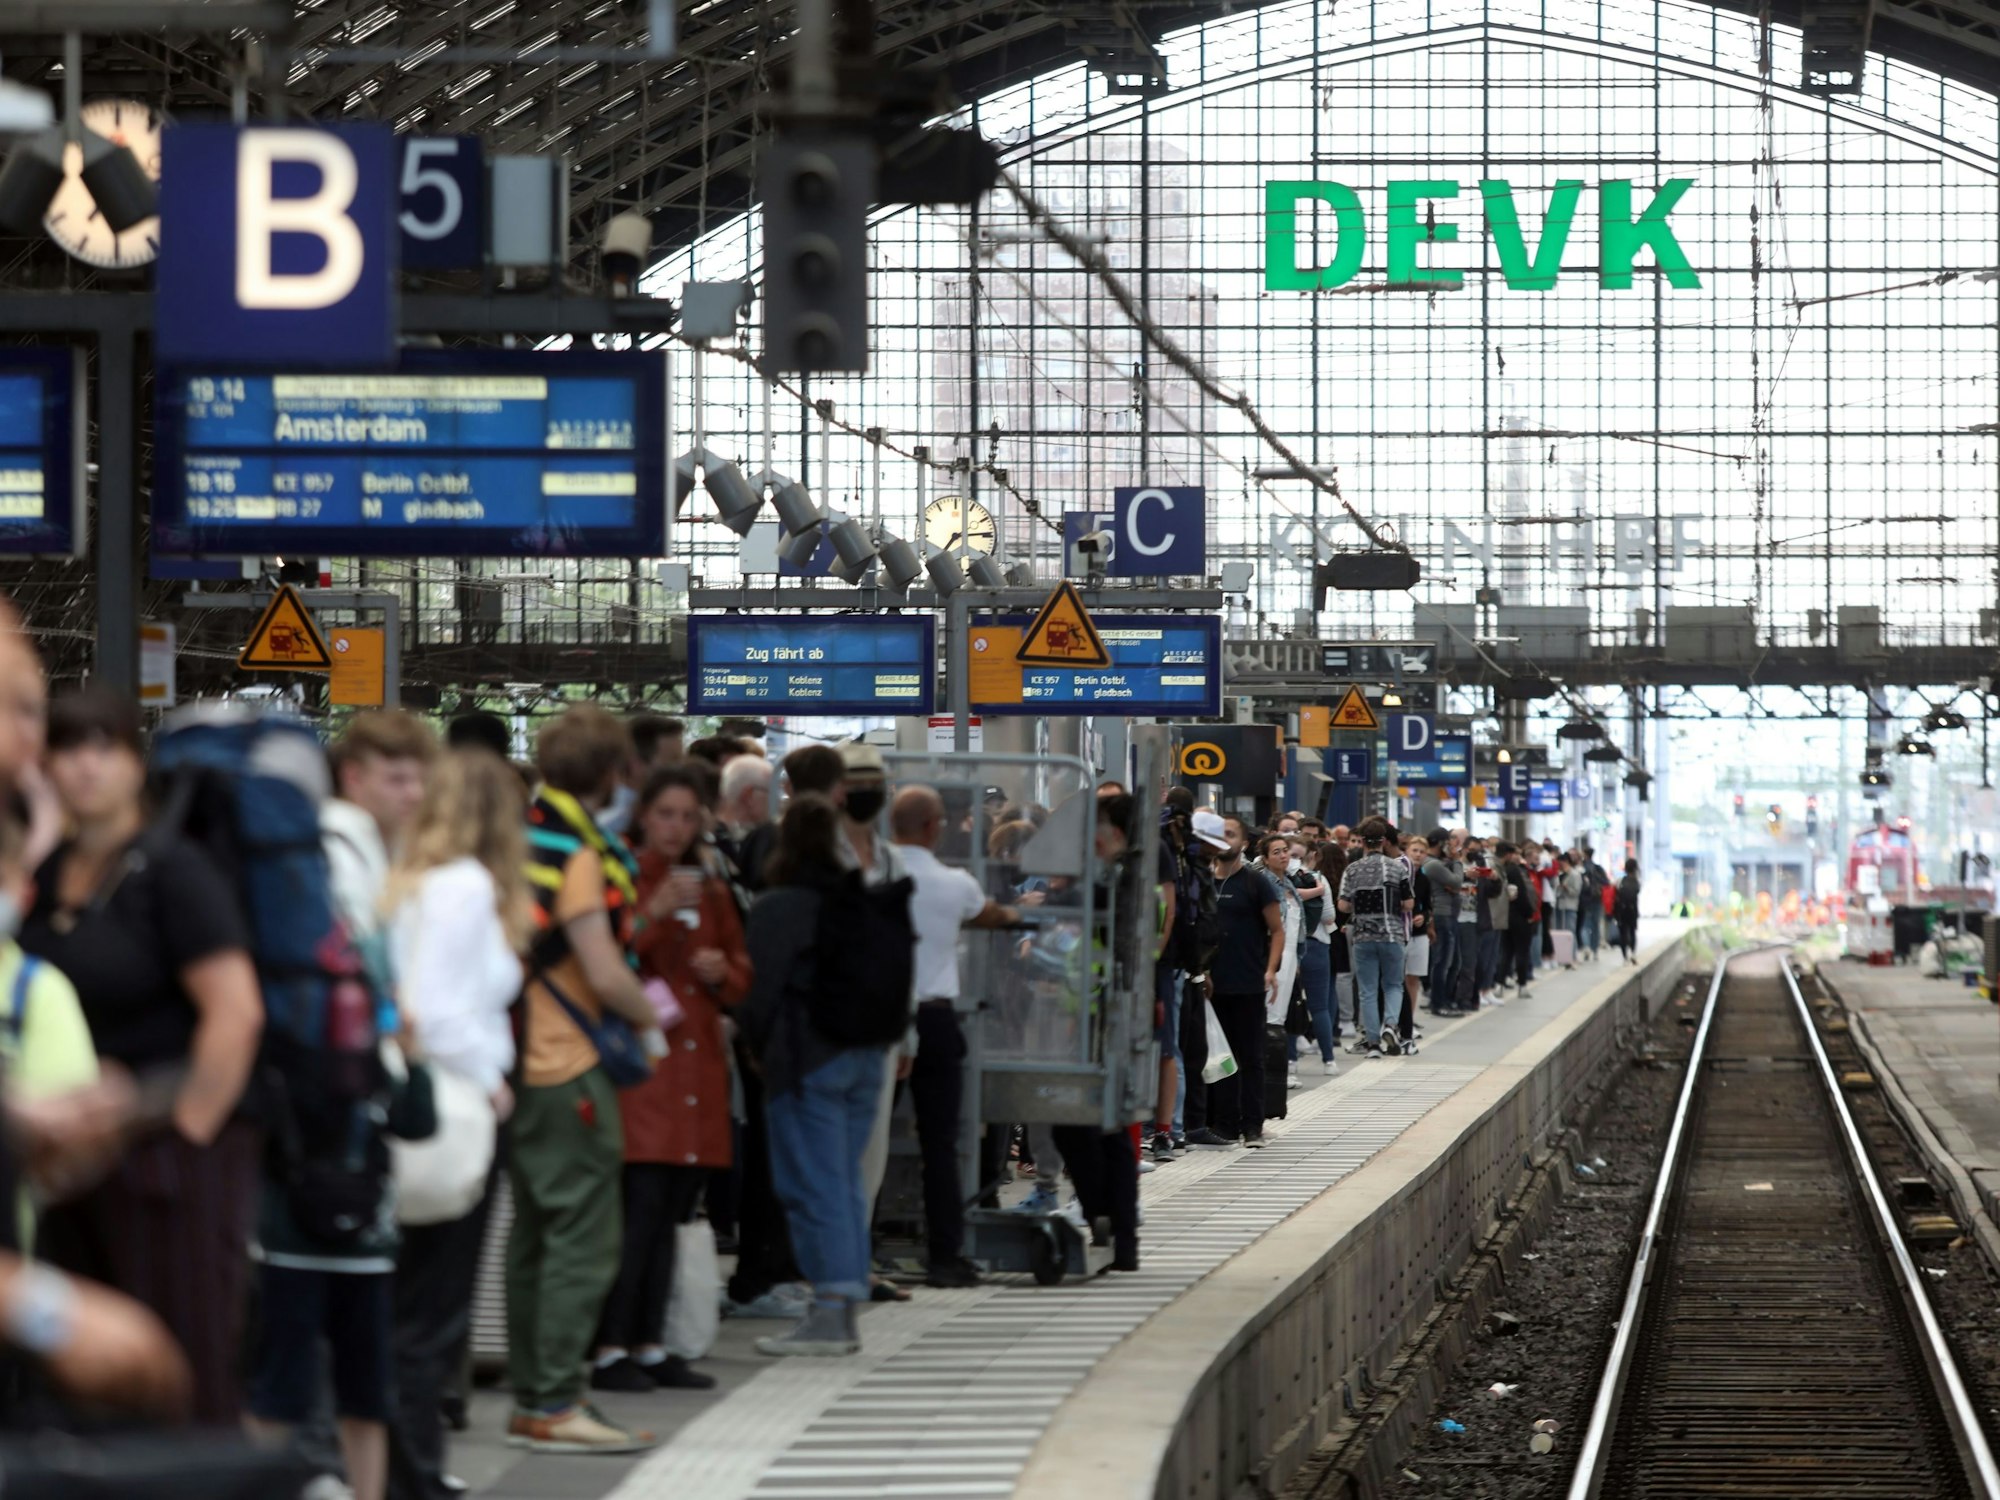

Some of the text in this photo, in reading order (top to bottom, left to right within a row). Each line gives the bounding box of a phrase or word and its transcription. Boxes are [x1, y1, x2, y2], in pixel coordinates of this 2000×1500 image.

[398, 140, 463, 240] 5
[236, 128, 364, 310] B
[1265, 178, 1703, 291] DEVK
[274, 413, 427, 442] Amsterdam
[362, 472, 415, 494] Berlin
[362, 498, 383, 519] M
[403, 498, 485, 524] gladbach
[1126, 490, 1176, 557] C
[746, 647, 824, 662] Zug fährt ab
[703, 675, 727, 684] 19:44
[758, 676, 769, 684] 27
[788, 675, 823, 685] Koblenz
[703, 687, 727, 697] 20:44
[745, 688, 757, 697] RB
[758, 688, 769, 697] 27
[788, 687, 823, 697] Koblenz
[1030, 675, 1044, 684] ICE
[1044, 675, 1060, 684] 957
[1074, 675, 1098, 685] Berlin
[1100, 675, 1127, 685] Ostbf.
[1031, 687, 1043, 697] RB
[1044, 687, 1055, 697] 27
[1073, 688, 1084, 697] M
[1093, 687, 1133, 698] gladbach
[1402, 714, 1429, 751] D
[1511, 764, 1528, 791] E
